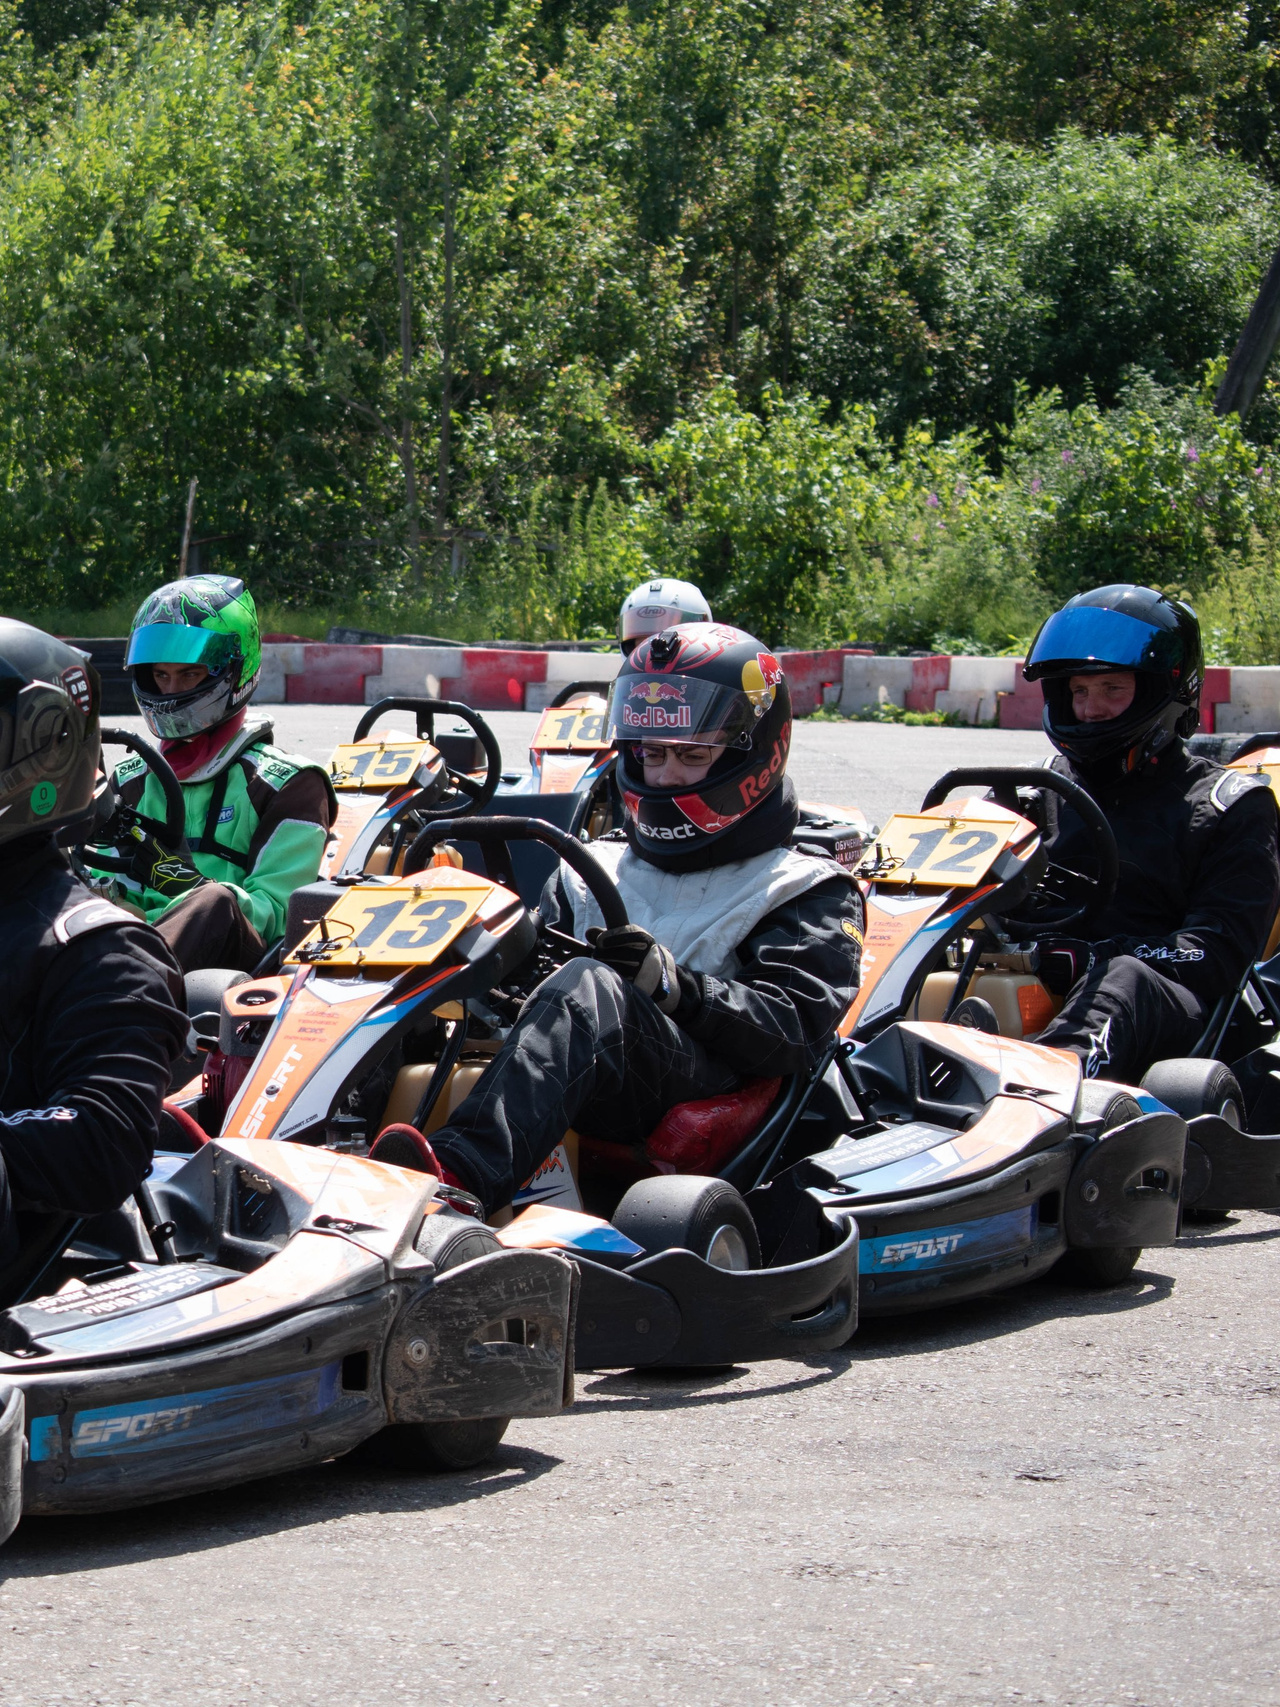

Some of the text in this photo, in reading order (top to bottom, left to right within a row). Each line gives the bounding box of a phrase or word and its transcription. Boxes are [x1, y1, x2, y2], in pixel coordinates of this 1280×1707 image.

[641, 606, 664, 616] Arai
[77, 680, 88, 692] KG
[554, 715, 606, 741] 18
[623, 704, 692, 728] Red Bull
[119, 759, 142, 774] OMP
[267, 762, 292, 778] OMP
[348, 749, 416, 779] 15
[738, 741, 782, 807] Red
[896, 827, 1000, 874] 12
[349, 898, 468, 950] 13
[880, 1233, 964, 1265] SPORT
[75, 1403, 202, 1445] SPORT
